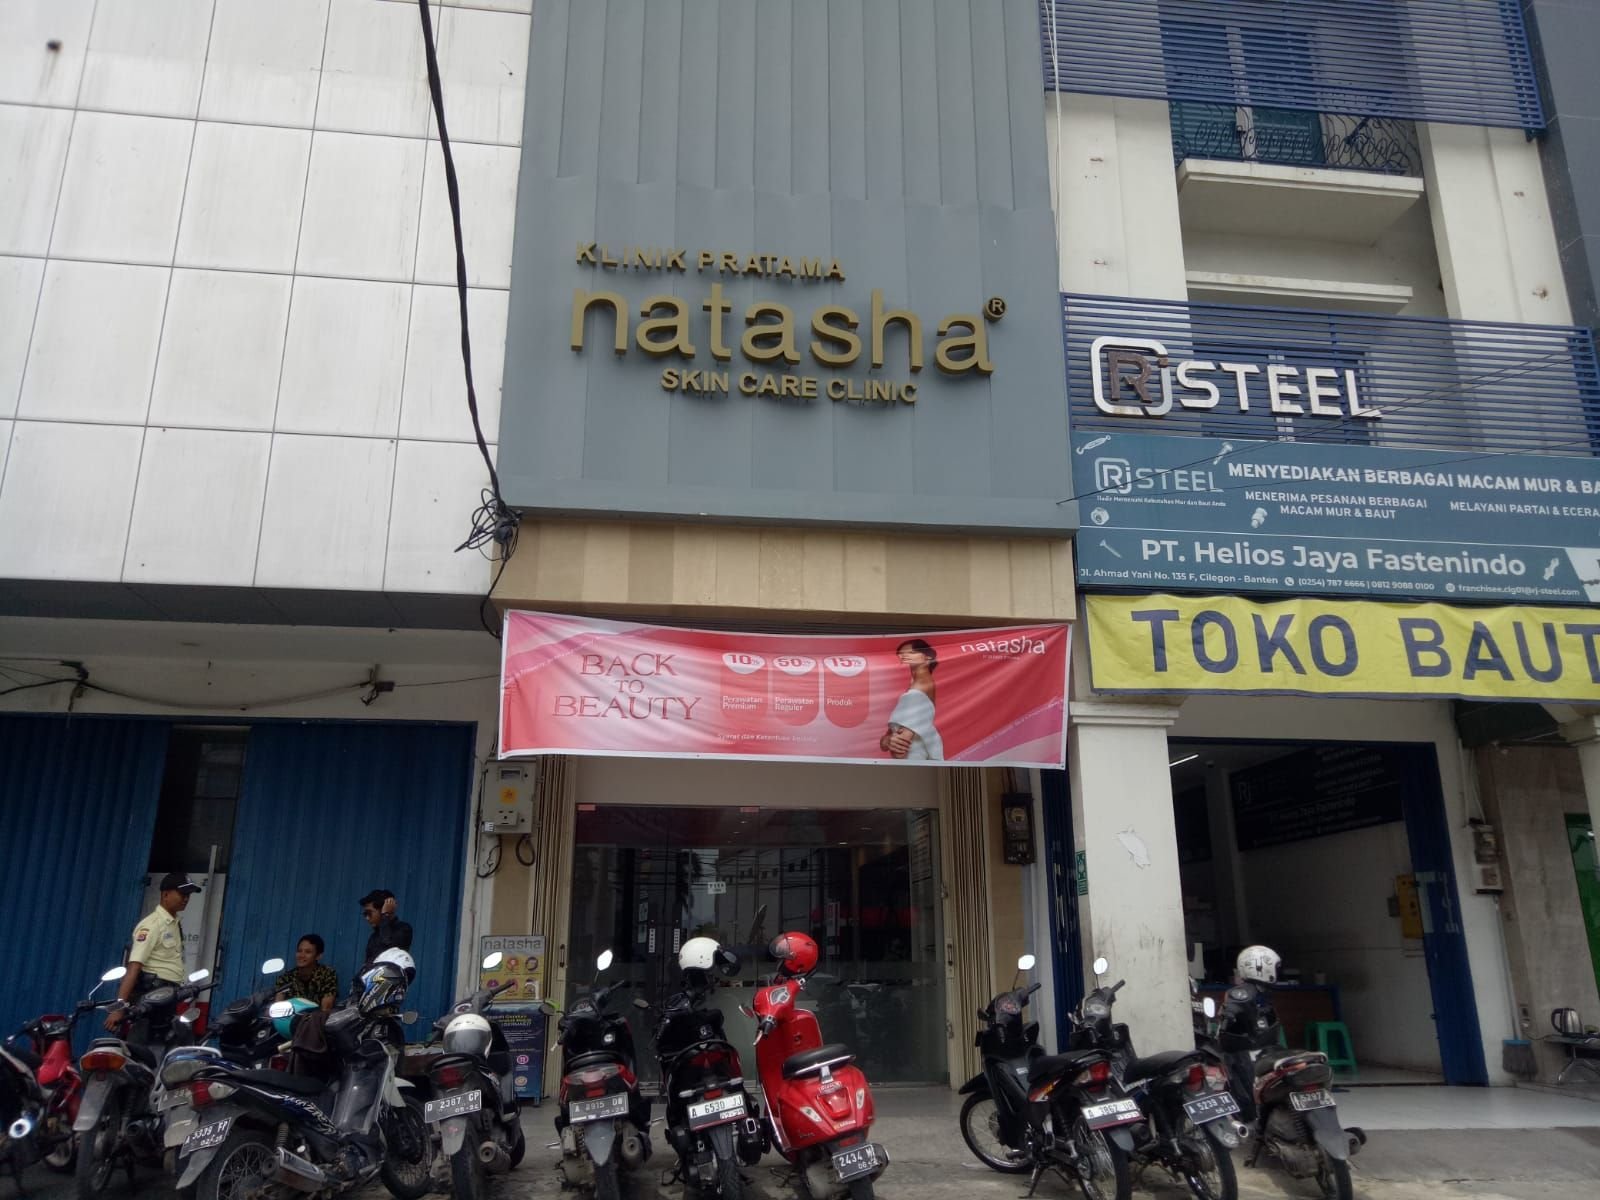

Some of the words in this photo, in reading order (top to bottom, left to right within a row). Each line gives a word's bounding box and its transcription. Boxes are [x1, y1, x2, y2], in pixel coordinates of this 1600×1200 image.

[576, 242, 687, 273] KLINIK
[697, 248, 846, 281] PRATAMA
[570, 283, 994, 375] natasha
[660, 368, 729, 393] SKIN
[738, 373, 818, 398] CARE
[826, 378, 918, 403] CLINIC
[1176, 360, 1383, 419] STEEL
[1136, 466, 1224, 493] STEEL
[1228, 462, 1360, 484] MENYEDIAKAN
[1364, 469, 1453, 488] BERBAGAI
[1458, 474, 1520, 491] MACAM
[1523, 477, 1562, 493] MUR
[1566, 479, 1578, 494] &
[1245, 491, 1309, 503] MENERIMA
[1311, 494, 1366, 505] PESANAN
[1369, 497, 1427, 508] BERBAGAI
[1450, 501, 1507, 513] MELAYANI
[1510, 504, 1550, 516] PARTAI
[1552, 506, 1560, 516] &
[1280, 504, 1323, 516] MACAM
[1326, 507, 1352, 517] MUR
[1354, 509, 1362, 517] &
[1364, 509, 1397, 519] BAUT
[1141, 538, 1186, 562] PT.
[1195, 541, 1286, 566] Helios
[1292, 545, 1358, 574] Jaya
[1366, 548, 1527, 576] Fastenindo
[1093, 569, 1129, 579] Ahmad
[1131, 571, 1152, 580] Yani
[1154, 572, 1170, 581] No.
[1172, 573, 1187, 581] 135
[1199, 573, 1236, 584] Cilegon
[1244, 576, 1279, 585] Banten
[1298, 577, 1325, 588] (0254)
[961, 636, 1045, 655] natasha
[1130, 608, 1359, 676] TOKO
[1397, 616, 1600, 684] BAUT
[580, 653, 678, 676] BACK
[615, 679, 645, 694] TO
[552, 695, 701, 720] BEAUTY
[722, 695, 763, 704] Perawatan
[722, 703, 757, 711] Premium
[774, 696, 814, 705] Perawatan
[826, 698, 853, 707] Produk
[484, 938, 541, 951] natasha
[691, 1107, 697, 1118] A
[704, 1100, 726, 1114] 6530
